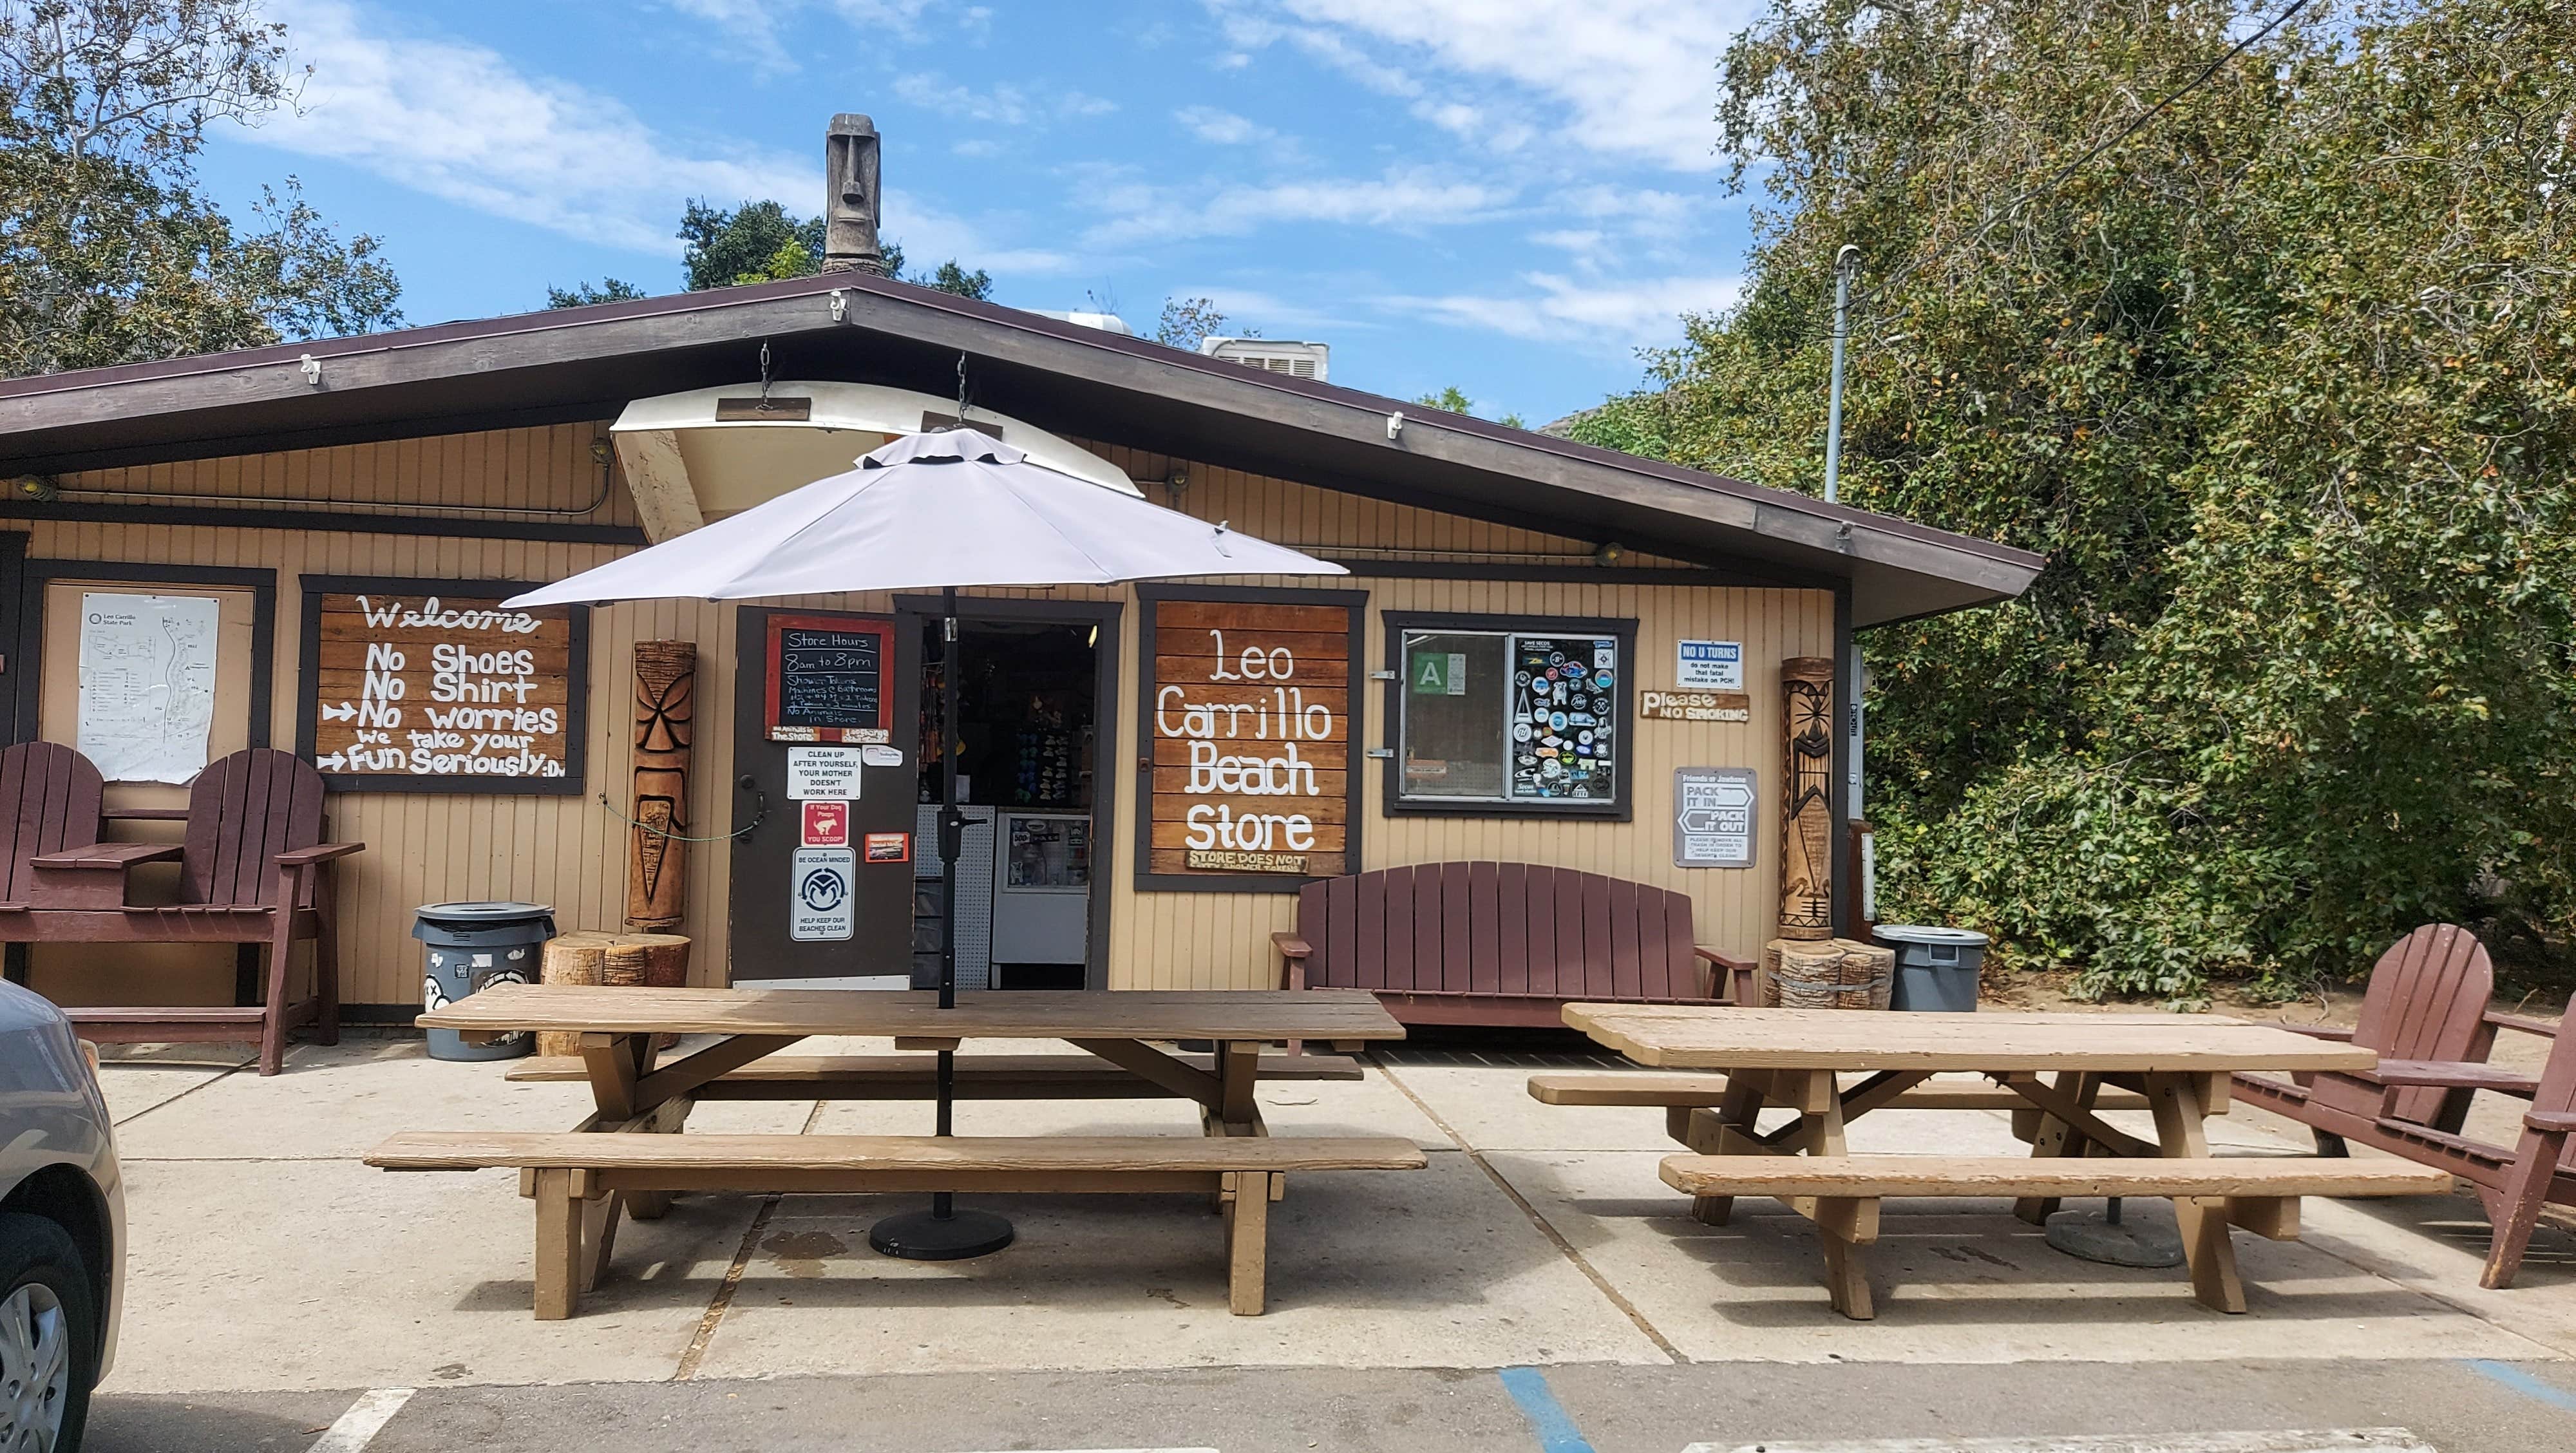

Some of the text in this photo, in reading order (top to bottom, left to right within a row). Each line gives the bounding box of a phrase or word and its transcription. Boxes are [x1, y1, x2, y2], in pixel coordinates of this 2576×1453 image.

[355, 595, 542, 633] Welcome
[788, 632, 868, 647] Store Hours
[365, 643, 534, 675] No Shoes
[785, 652, 871, 672] 8am to 8pm
[1209, 629, 1294, 681] Leo
[1683, 645, 1737, 659] NO U TURNS
[1419, 661, 1441, 685] A
[362, 670, 538, 703] No Shirt
[358, 700, 402, 728] No
[787, 708, 843, 716] No Animals
[1157, 685, 1332, 740] Carrillo
[1660, 707, 1748, 722] NO SMOKING
[407, 729, 464, 748] take
[471, 733, 535, 755] your
[347, 743, 406, 771] Fun
[1184, 739, 1320, 795] Beach
[1687, 786, 1719, 796] PACK
[1687, 797, 1716, 807] IT IN
[1185, 804, 1315, 851] Store
[1705, 821, 1745, 832] IT OUT
[1710, 811, 1745, 821] PACK
[1189, 850, 1306, 866] STORE DOES NOT
